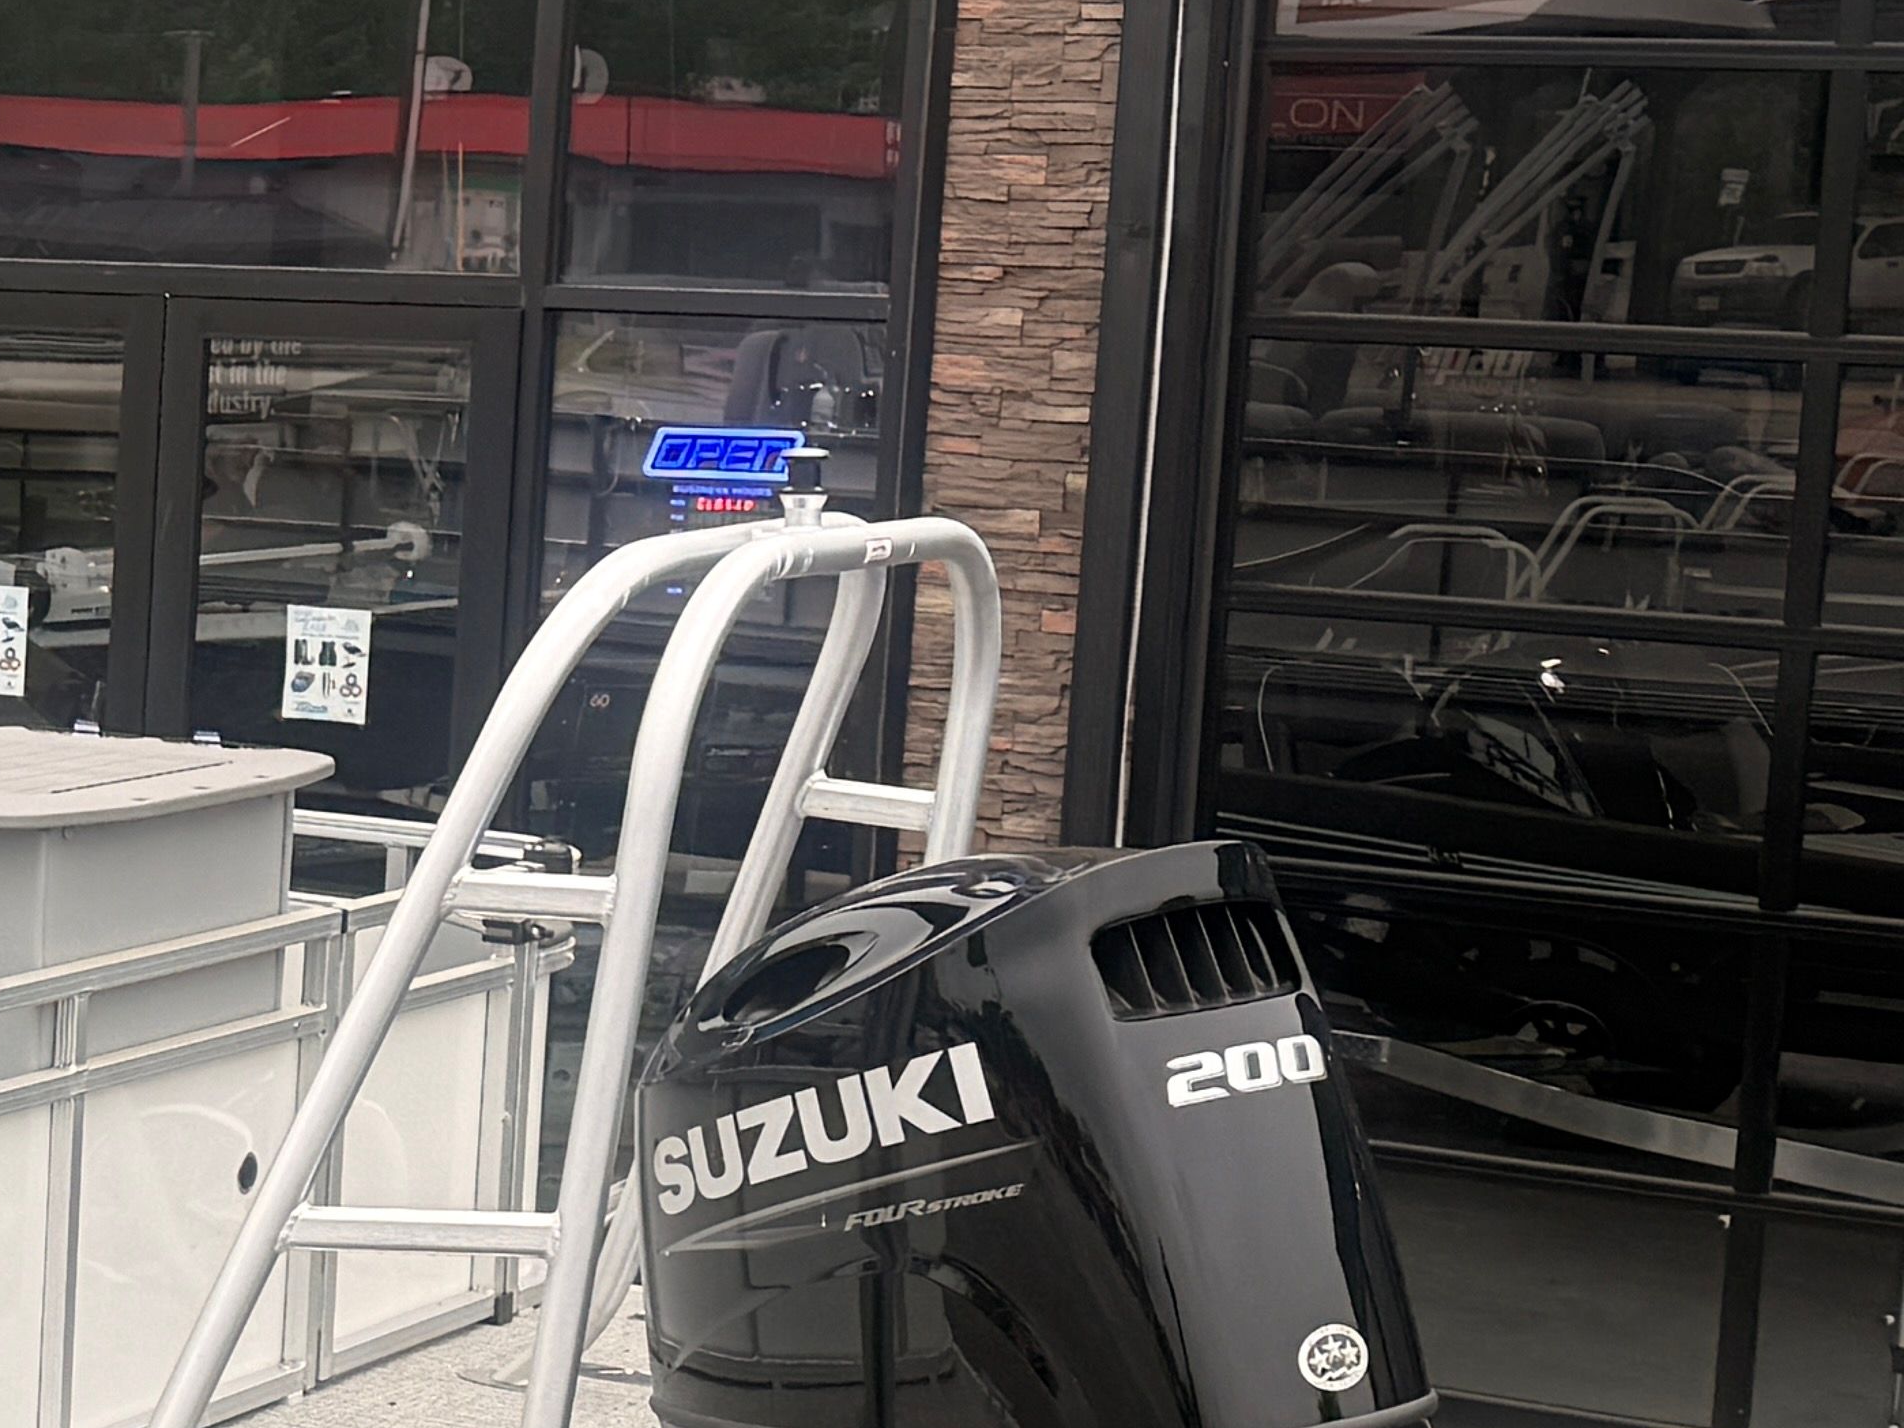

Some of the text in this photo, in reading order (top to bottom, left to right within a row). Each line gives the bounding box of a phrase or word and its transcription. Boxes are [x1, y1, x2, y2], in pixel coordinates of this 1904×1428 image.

[1271, 96, 1366, 131] ON
[1166, 1033, 1328, 1108] 200
[653, 1041, 996, 1215] SUZUKI
